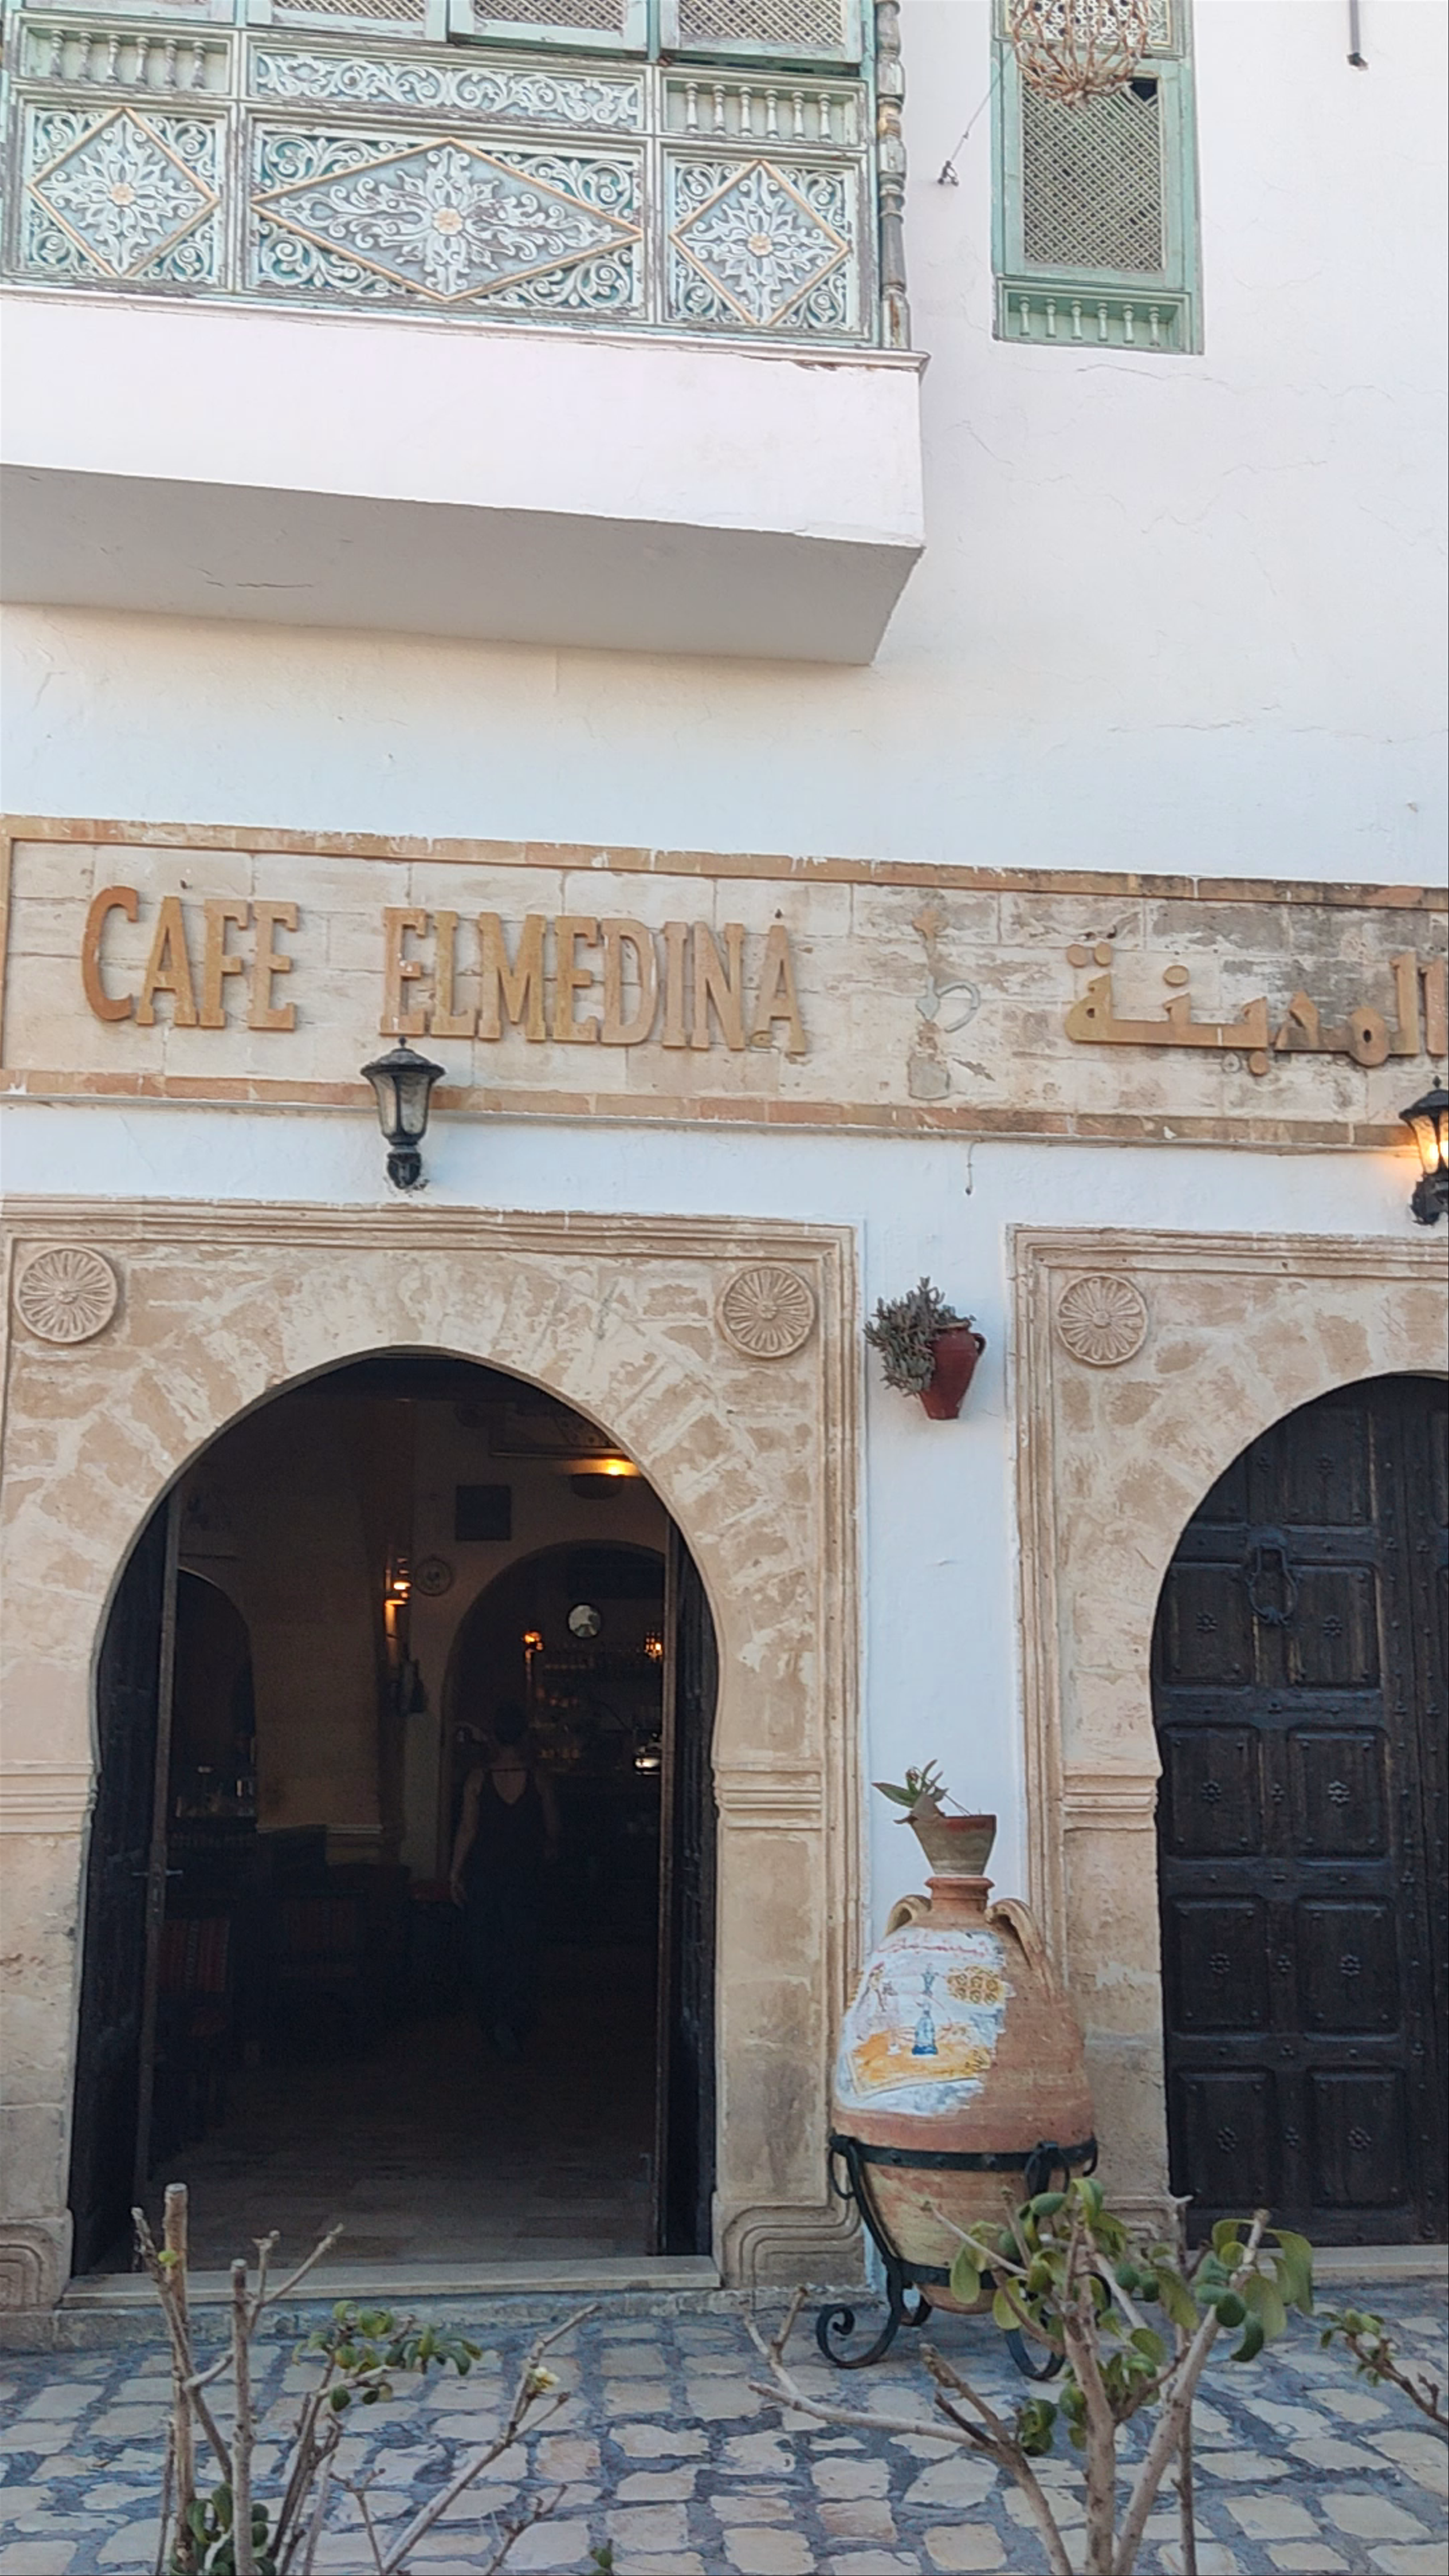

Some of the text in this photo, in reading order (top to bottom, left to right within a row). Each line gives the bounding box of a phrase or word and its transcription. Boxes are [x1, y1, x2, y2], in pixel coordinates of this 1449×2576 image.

[82, 885, 806, 1055] CAFE ELMEDINA
[1064, 941, 1448, 1077] المدينة
